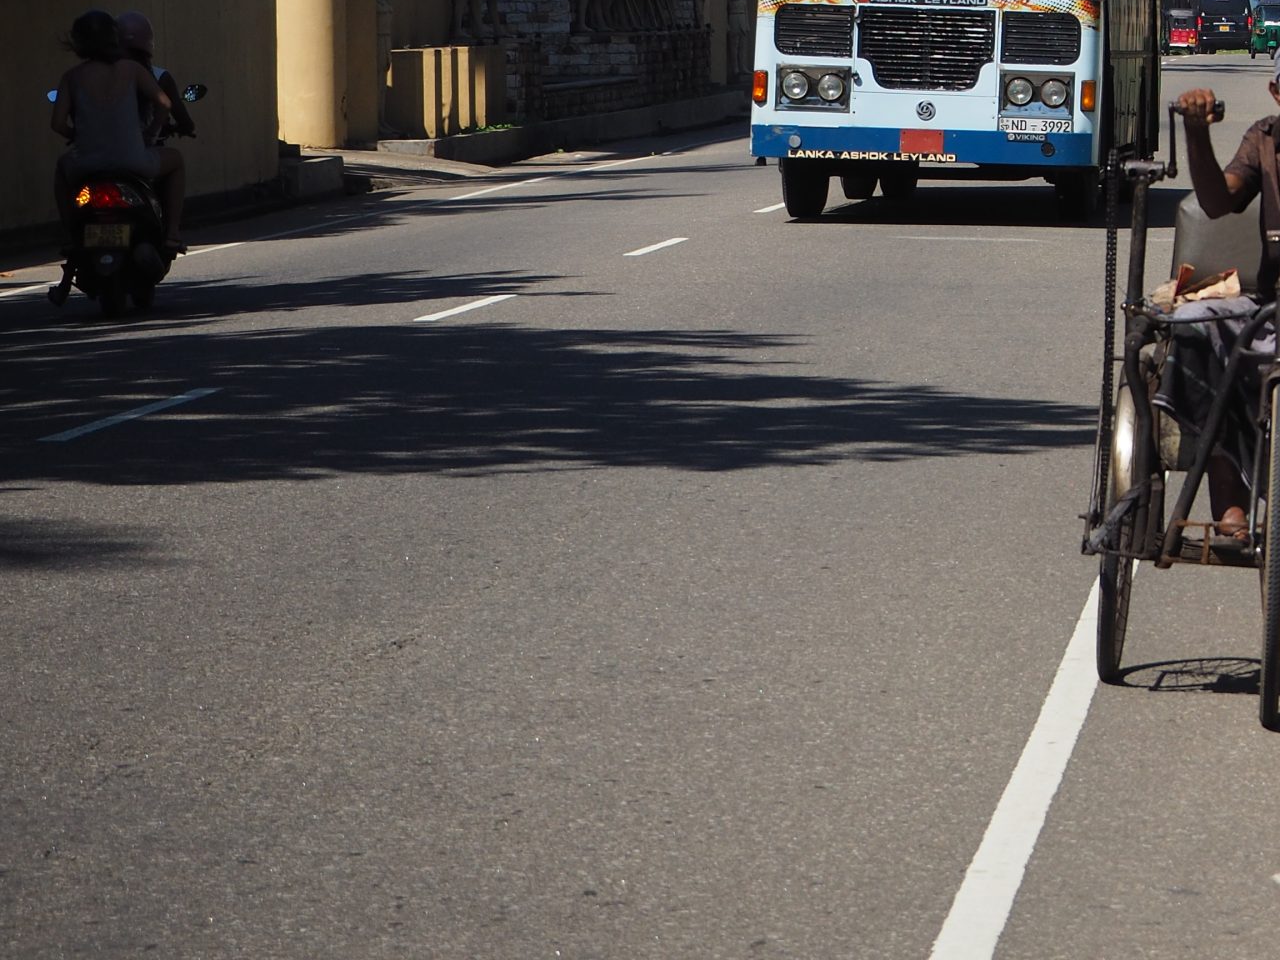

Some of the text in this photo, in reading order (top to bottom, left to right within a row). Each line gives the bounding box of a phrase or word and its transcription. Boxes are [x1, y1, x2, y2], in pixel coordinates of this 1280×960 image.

[1015, 133, 1046, 141] VIKING
[787, 149, 957, 162] LANKA ASHOK LEYLAND
